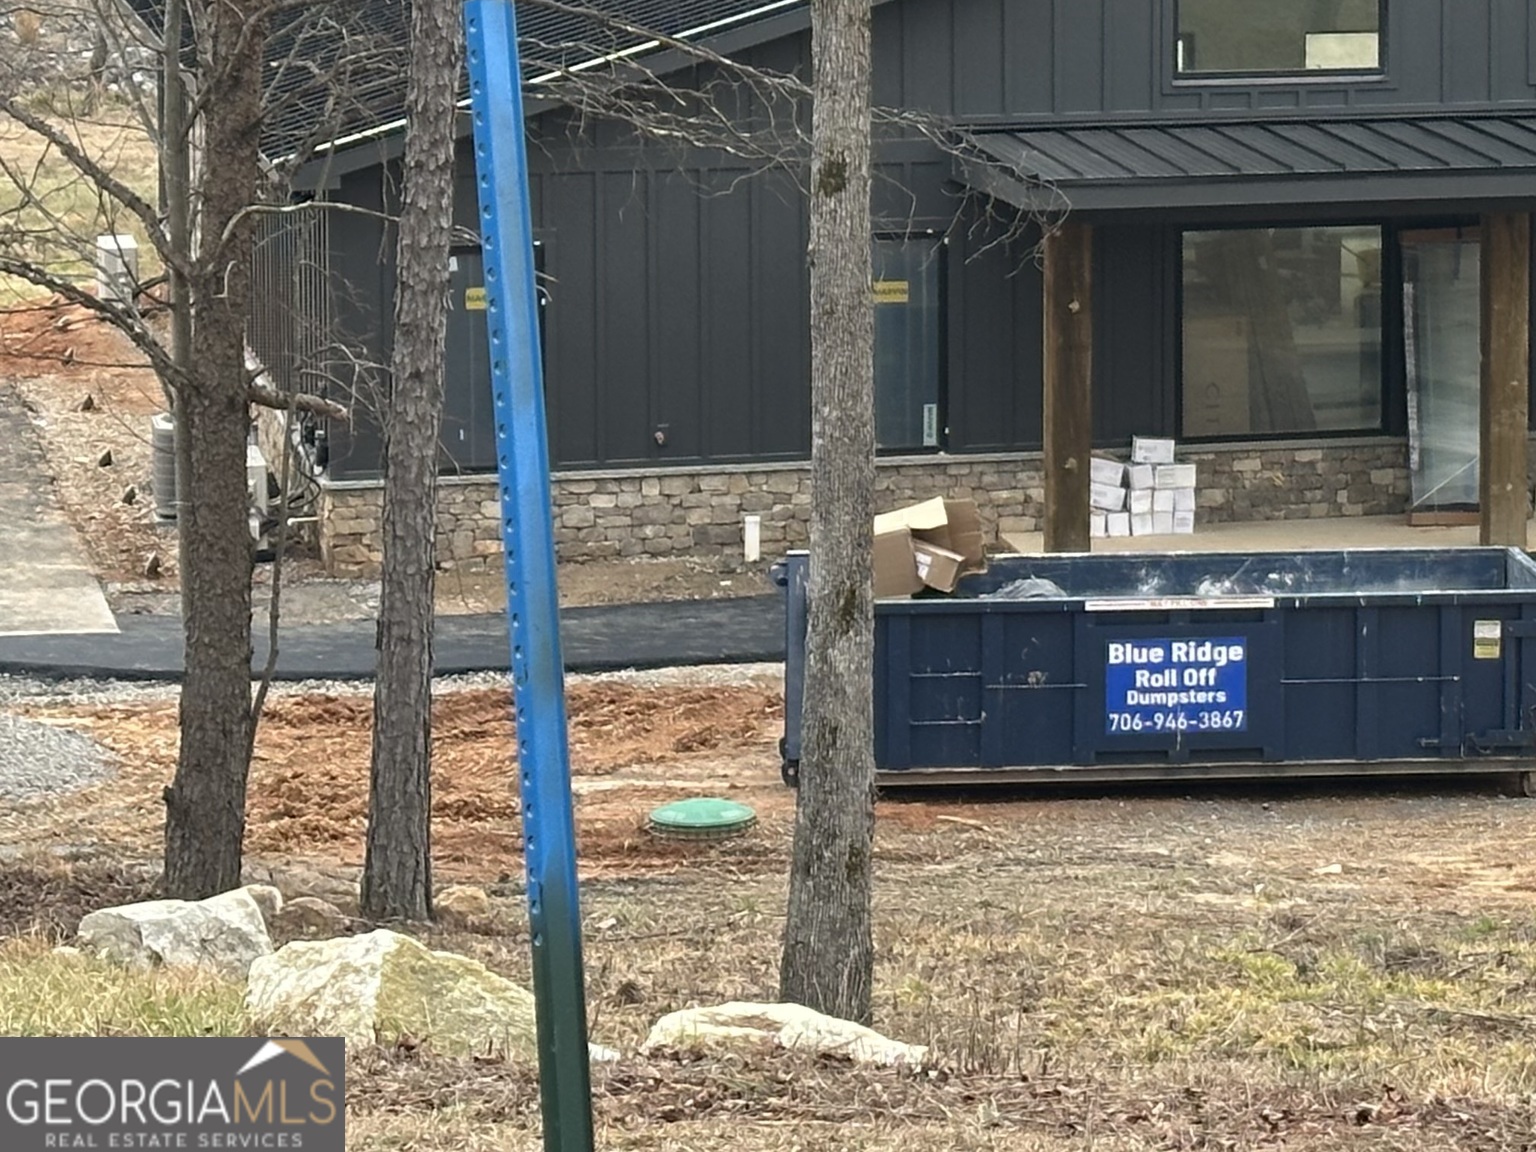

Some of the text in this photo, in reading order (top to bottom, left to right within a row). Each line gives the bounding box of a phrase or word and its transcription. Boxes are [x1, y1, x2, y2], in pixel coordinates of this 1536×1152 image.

[1108, 641, 1244, 667] Blue Ridge
[1135, 667, 1217, 688] Roll Off
[1126, 690, 1227, 708] Dumpsters
[1108, 710, 1244, 731] 706-946-3867
